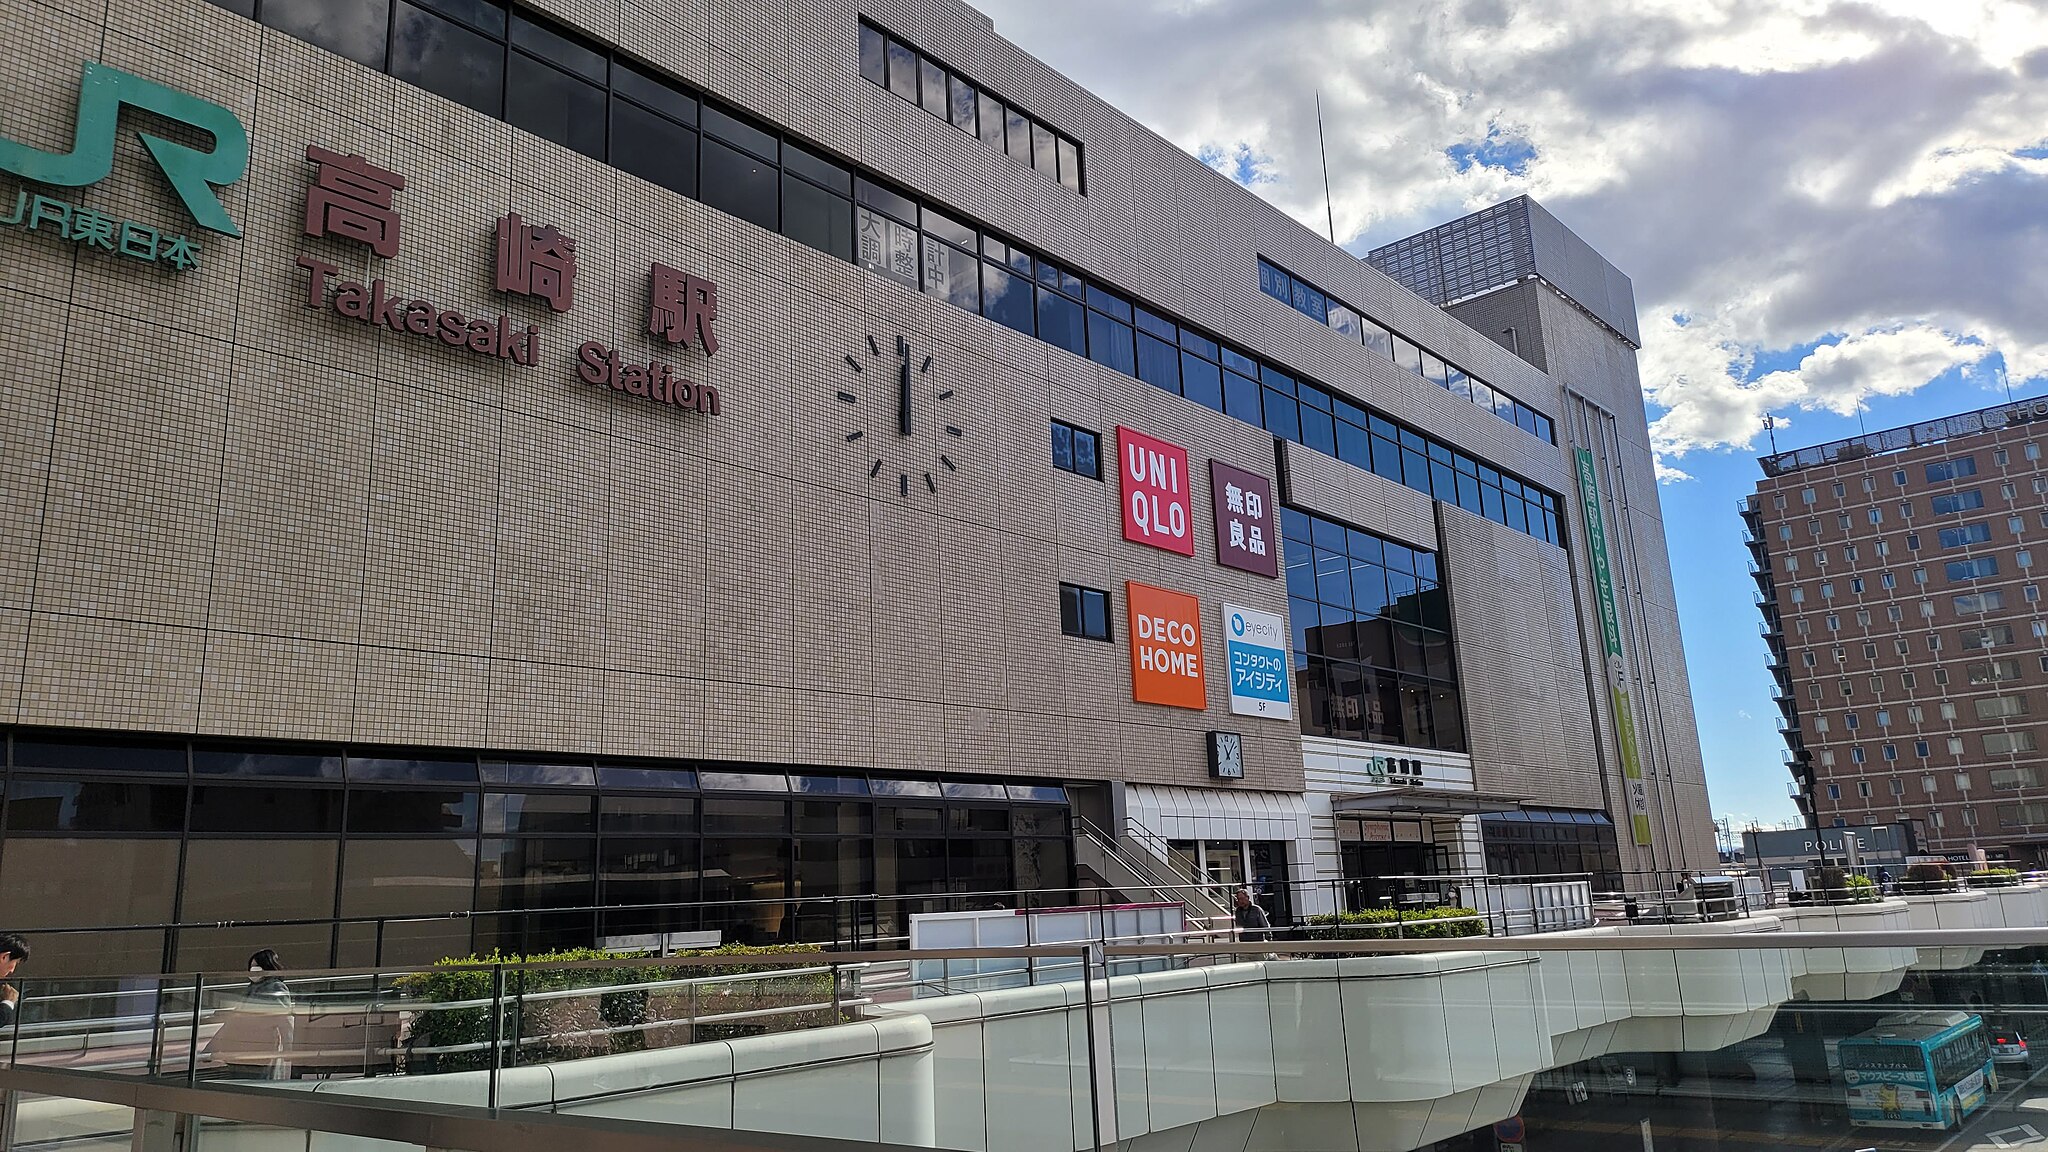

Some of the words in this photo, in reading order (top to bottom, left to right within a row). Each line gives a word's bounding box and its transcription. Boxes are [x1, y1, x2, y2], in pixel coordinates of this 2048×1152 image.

[0, 60, 248, 240] JR
[0, 191, 202, 272] JR東日本
[305, 145, 720, 357] 高崎駅
[296, 256, 539, 367] Takasaki
[577, 341, 721, 416] Station
[1129, 444, 1178, 494] UNI
[1132, 490, 1185, 538] QLO
[1225, 482, 1262, 520] 無印
[1229, 519, 1266, 557] 良品
[1138, 614, 1196, 647] DECO
[1245, 620, 1279, 641] eyecity
[1140, 645, 1198, 678] HOME
[1234, 651, 1282, 672] コンタクトの
[1235, 668, 1283, 693] アイシティ
[1258, 701, 1266, 712] 5F
[1366, 756, 1385, 776] JR
[1804, 837, 1866, 852] POLIE
